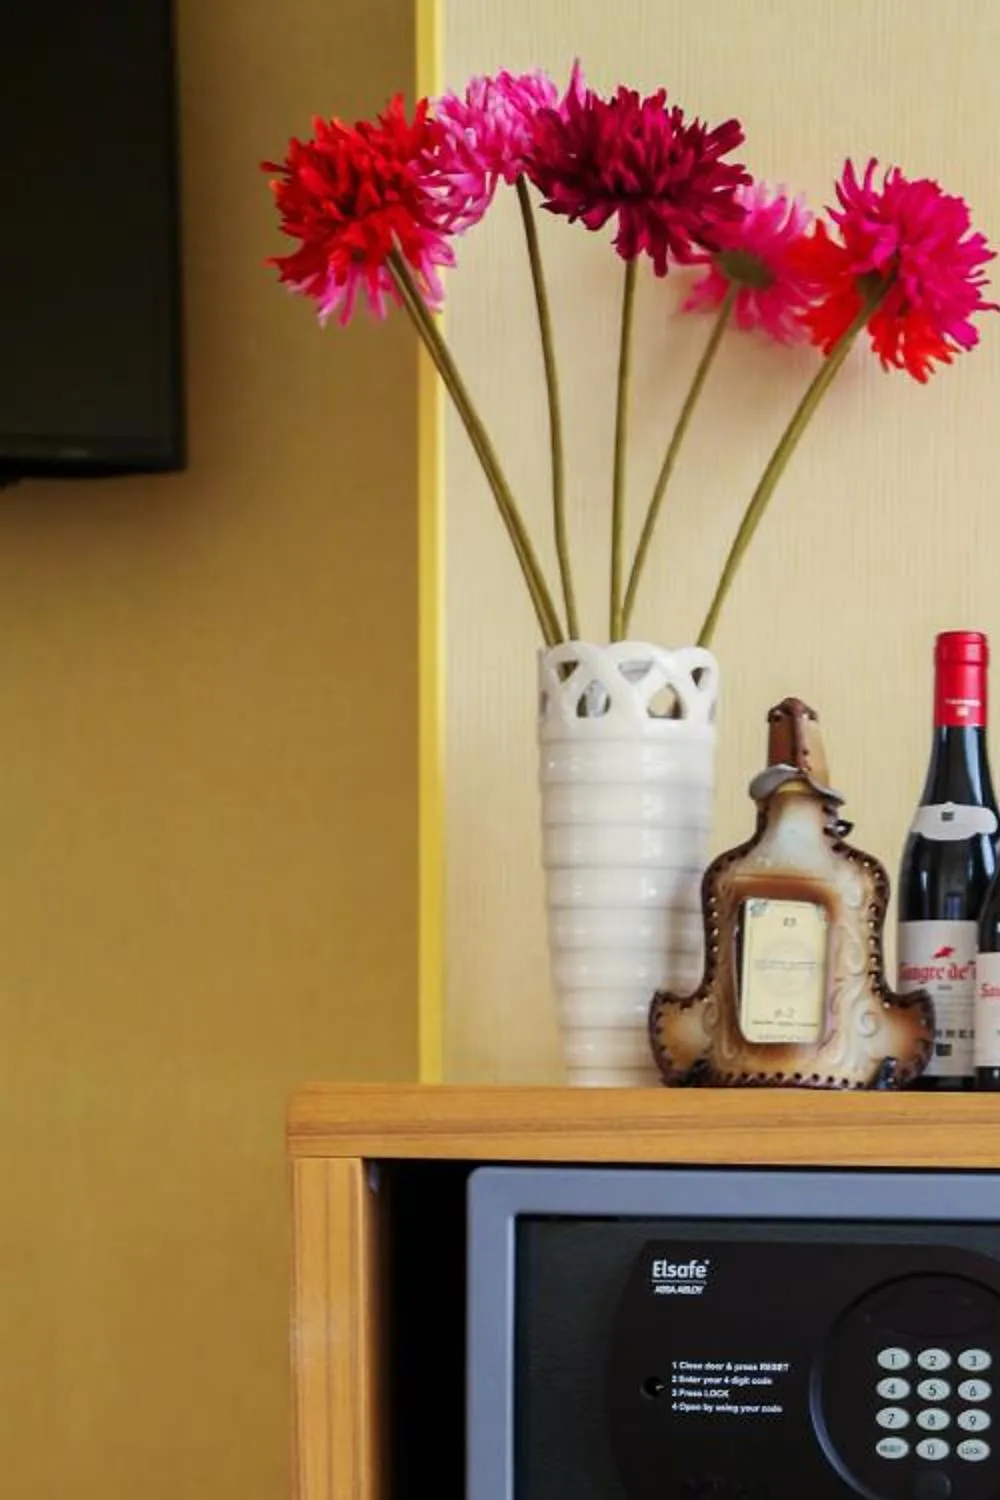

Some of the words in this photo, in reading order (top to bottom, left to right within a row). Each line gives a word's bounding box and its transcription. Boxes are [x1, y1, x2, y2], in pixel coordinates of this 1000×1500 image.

[900, 961, 945, 984] Sangre
[949, 962, 968, 980] de
[652, 1259, 707, 1278] Elsafe
[679, 1361, 703, 1370] Close
[704, 1362, 725, 1371] door
[734, 1363, 758, 1373] press
[760, 1363, 790, 1371] RESET
[928, 1355, 937, 1367] 2
[968, 1355, 978, 1367] 3
[679, 1375, 701, 1384] Enter
[703, 1376, 722, 1386] your
[731, 1376, 750, 1387] digit
[751, 1377, 774, 1386] code
[679, 1389, 703, 1398] Press
[704, 1389, 730, 1398] LOCK
[887, 1383, 896, 1396] 4
[927, 1384, 937, 1397] 5
[968, 1385, 978, 1398] 6
[679, 1403, 702, 1413] Open
[703, 1403, 714, 1413] by
[715, 1403, 739, 1414] using
[740, 1405, 760, 1414] your
[887, 1413, 896, 1425] 7
[927, 1414, 936, 1426] 8
[968, 1415, 977, 1426] 9
[927, 1444, 935, 1456] 0
